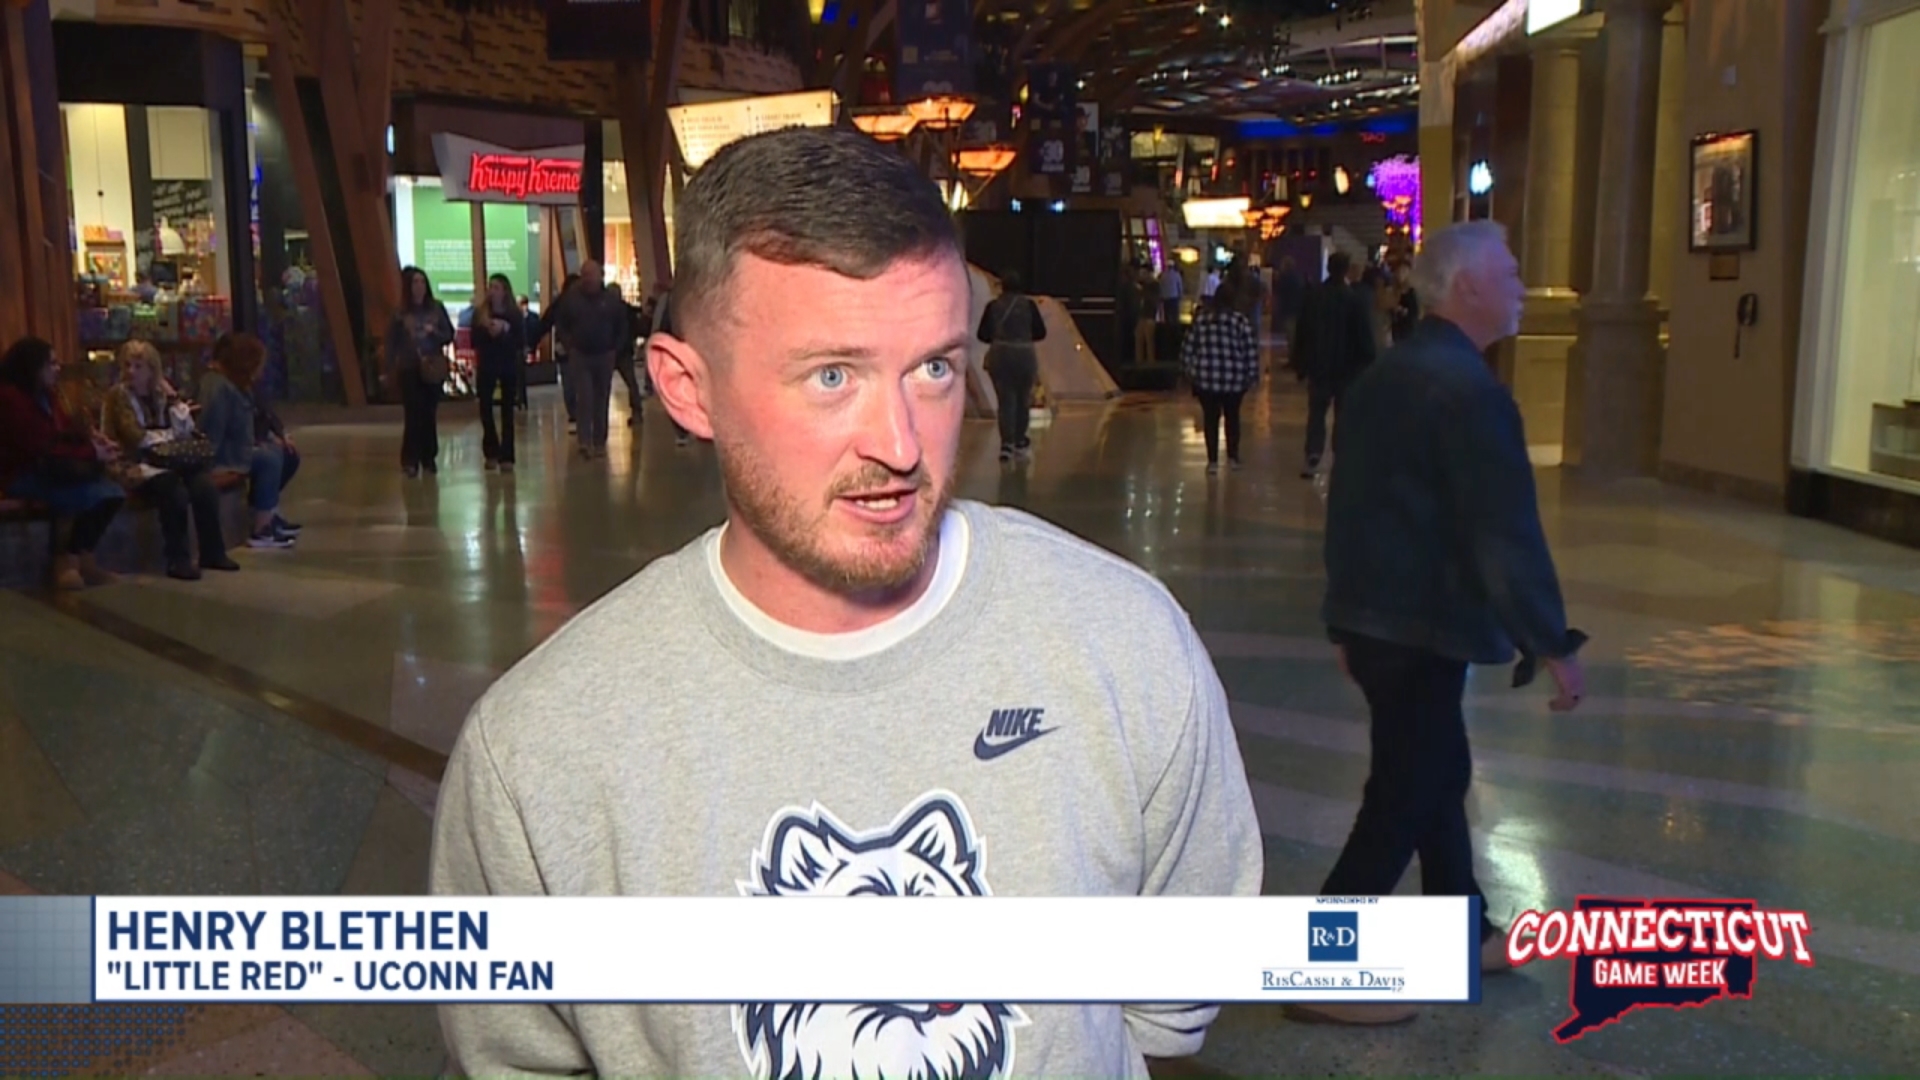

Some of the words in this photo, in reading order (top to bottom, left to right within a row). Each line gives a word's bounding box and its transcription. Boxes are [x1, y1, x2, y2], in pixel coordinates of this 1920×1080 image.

[469, 153, 529, 198] Krispy
[528, 156, 582, 193] Kreme
[985, 708, 1044, 737] NIKE
